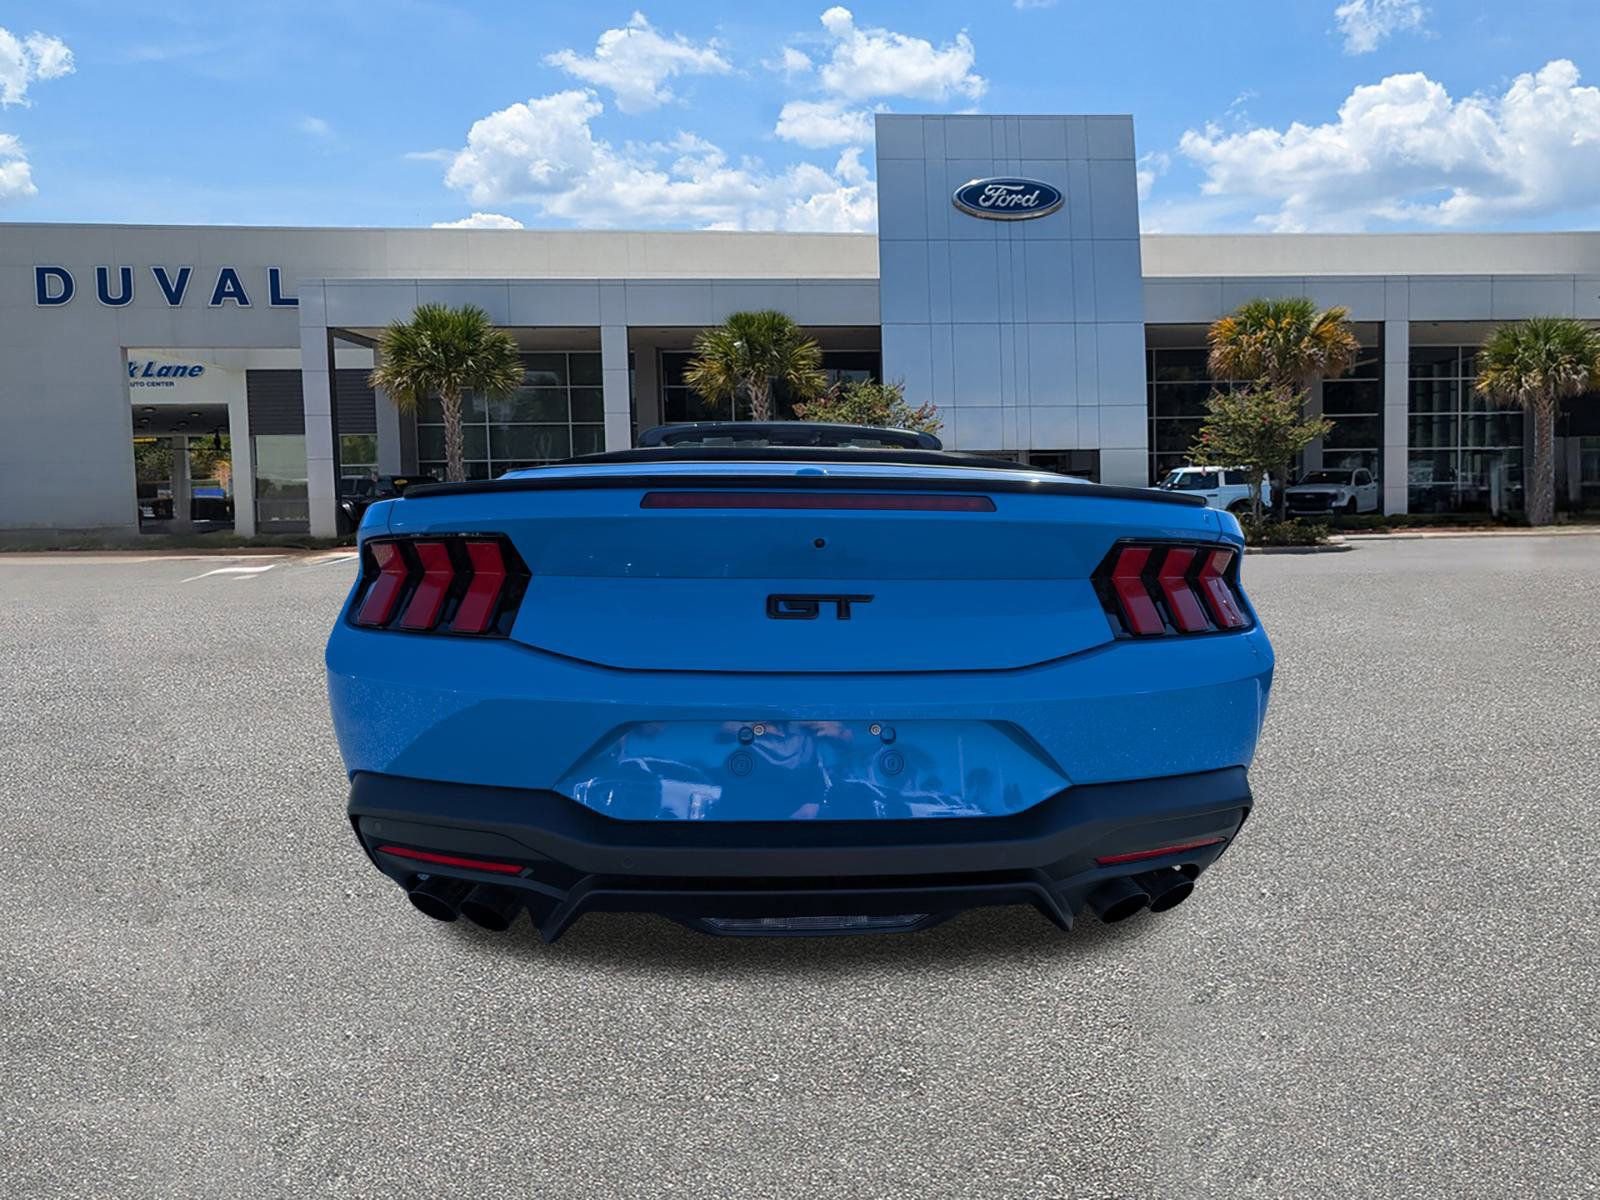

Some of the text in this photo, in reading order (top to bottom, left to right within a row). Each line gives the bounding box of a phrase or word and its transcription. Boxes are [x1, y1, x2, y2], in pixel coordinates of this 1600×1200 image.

[978, 184, 1040, 207] Ford
[33, 265, 299, 308] DUVAL
[141, 361, 204, 378] Lane
[766, 593, 875, 620] GT
